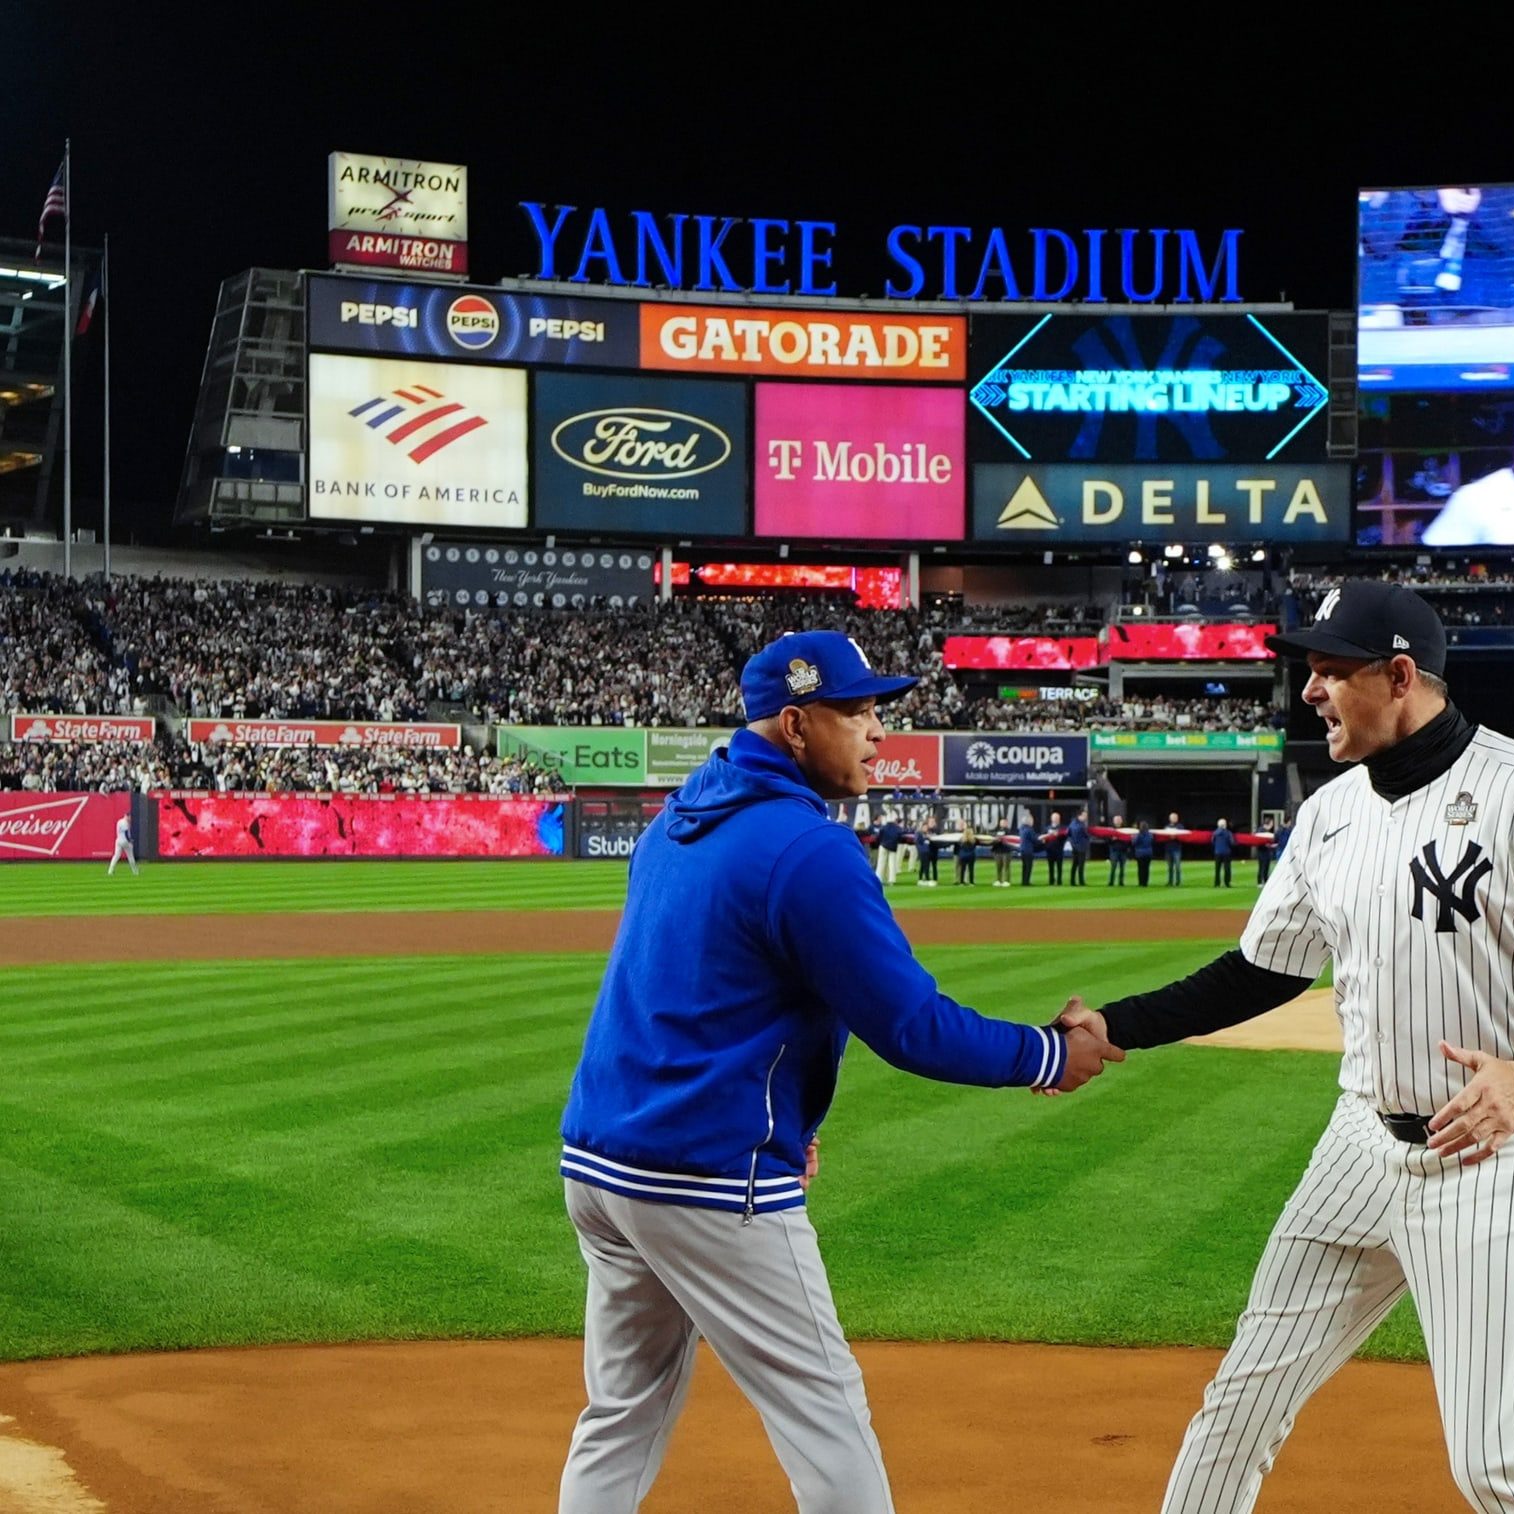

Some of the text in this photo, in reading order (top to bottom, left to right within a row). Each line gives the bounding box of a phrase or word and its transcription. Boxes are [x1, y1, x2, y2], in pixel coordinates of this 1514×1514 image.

[341, 166, 459, 192] ARMITRON
[346, 235, 454, 259] ARMITRON
[519, 201, 1244, 302] YANKEE STADIUM
[399, 255, 453, 270] WATCHES
[341, 302, 418, 328] PEPSI
[451, 315, 496, 330] PEPSI
[529, 318, 605, 342] PEPSI
[660, 316, 952, 368] GATORADE
[1008, 383, 1291, 412] STARTING LINEUP
[583, 415, 699, 470] Ford
[814, 440, 952, 485] Mobile
[315, 479, 519, 504] BANK OF AMERICA
[583, 483, 699, 500] BuyFordNow.com
[1082, 479, 1329, 525] DELTA
[490, 568, 517, 582] New
[516, 569, 545, 590] York
[575, 745, 640, 769] Eats
[996, 746, 1064, 769] coupa
[965, 771, 989, 781] Make
[990, 771, 1025, 782] Margins
[587, 835, 634, 856] Stub
[1408, 839, 1493, 933] NY
